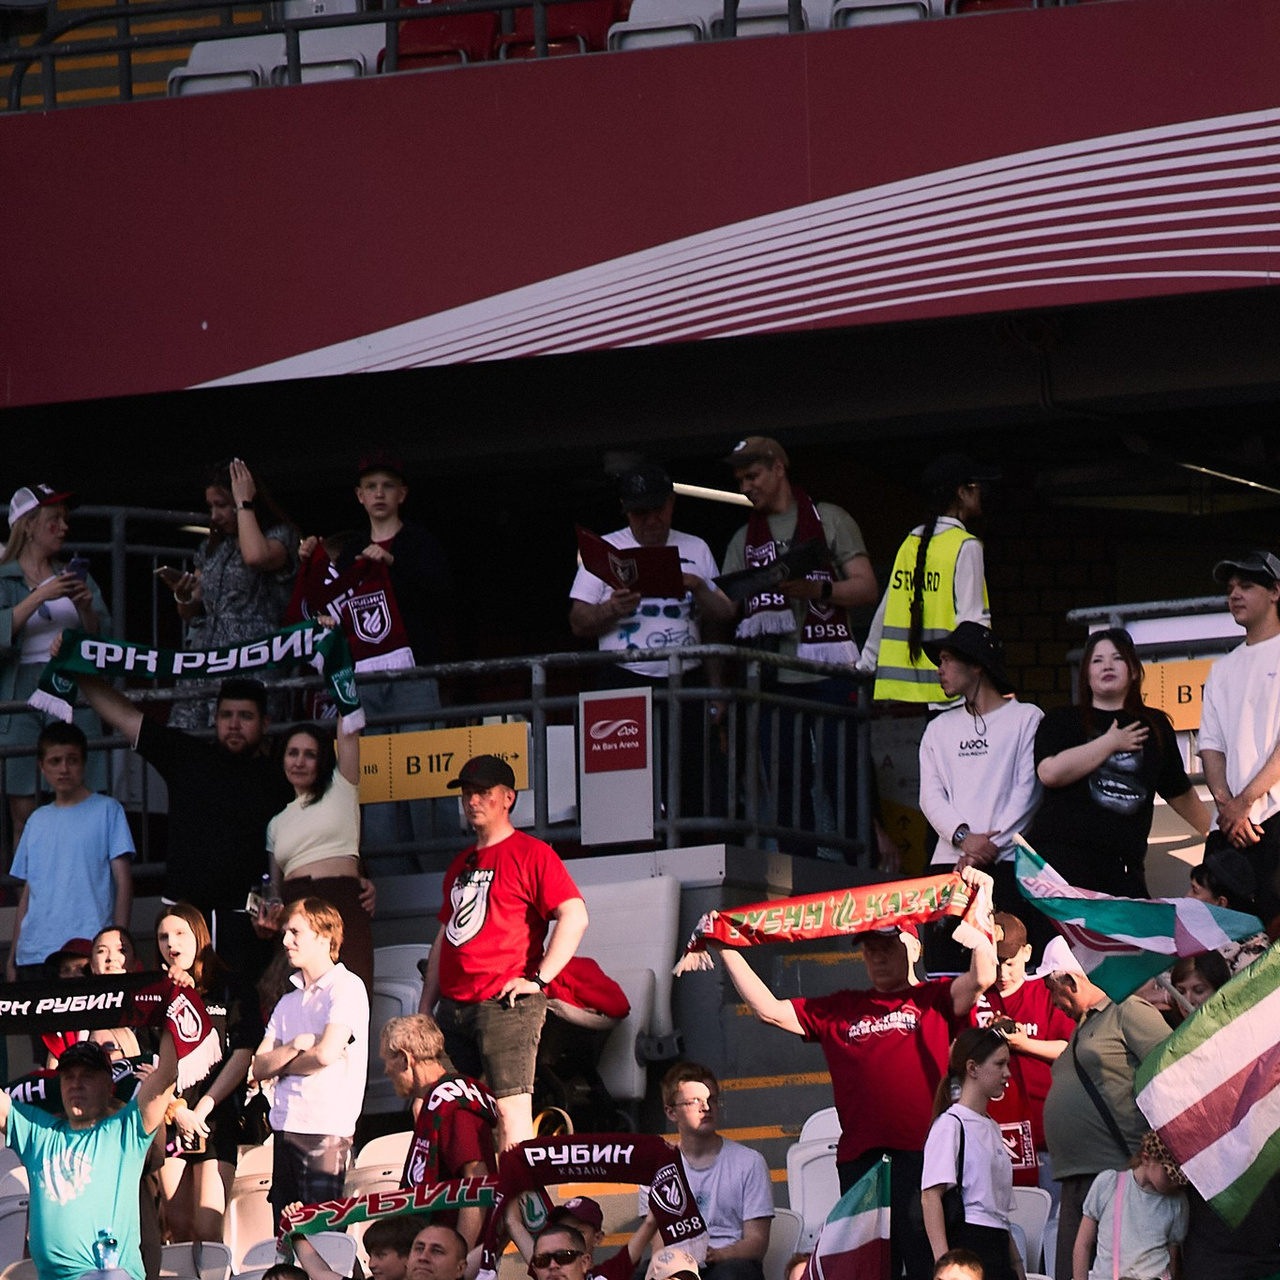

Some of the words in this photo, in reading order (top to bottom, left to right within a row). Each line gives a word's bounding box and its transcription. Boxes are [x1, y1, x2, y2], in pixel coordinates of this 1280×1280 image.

[804, 622, 849, 640] 1958
[80, 639, 159, 675] ФК
[591, 742, 602, 752] Ak
[603, 741, 618, 751] Bars
[619, 740, 640, 750] Arena
[428, 752, 455, 773] 117
[36, 990, 125, 1015] РУБИН
[524, 1143, 634, 1167] РУБИН
[559, 1166, 607, 1177] КАЗАНЬ
[666, 1215, 702, 1238] 1958
